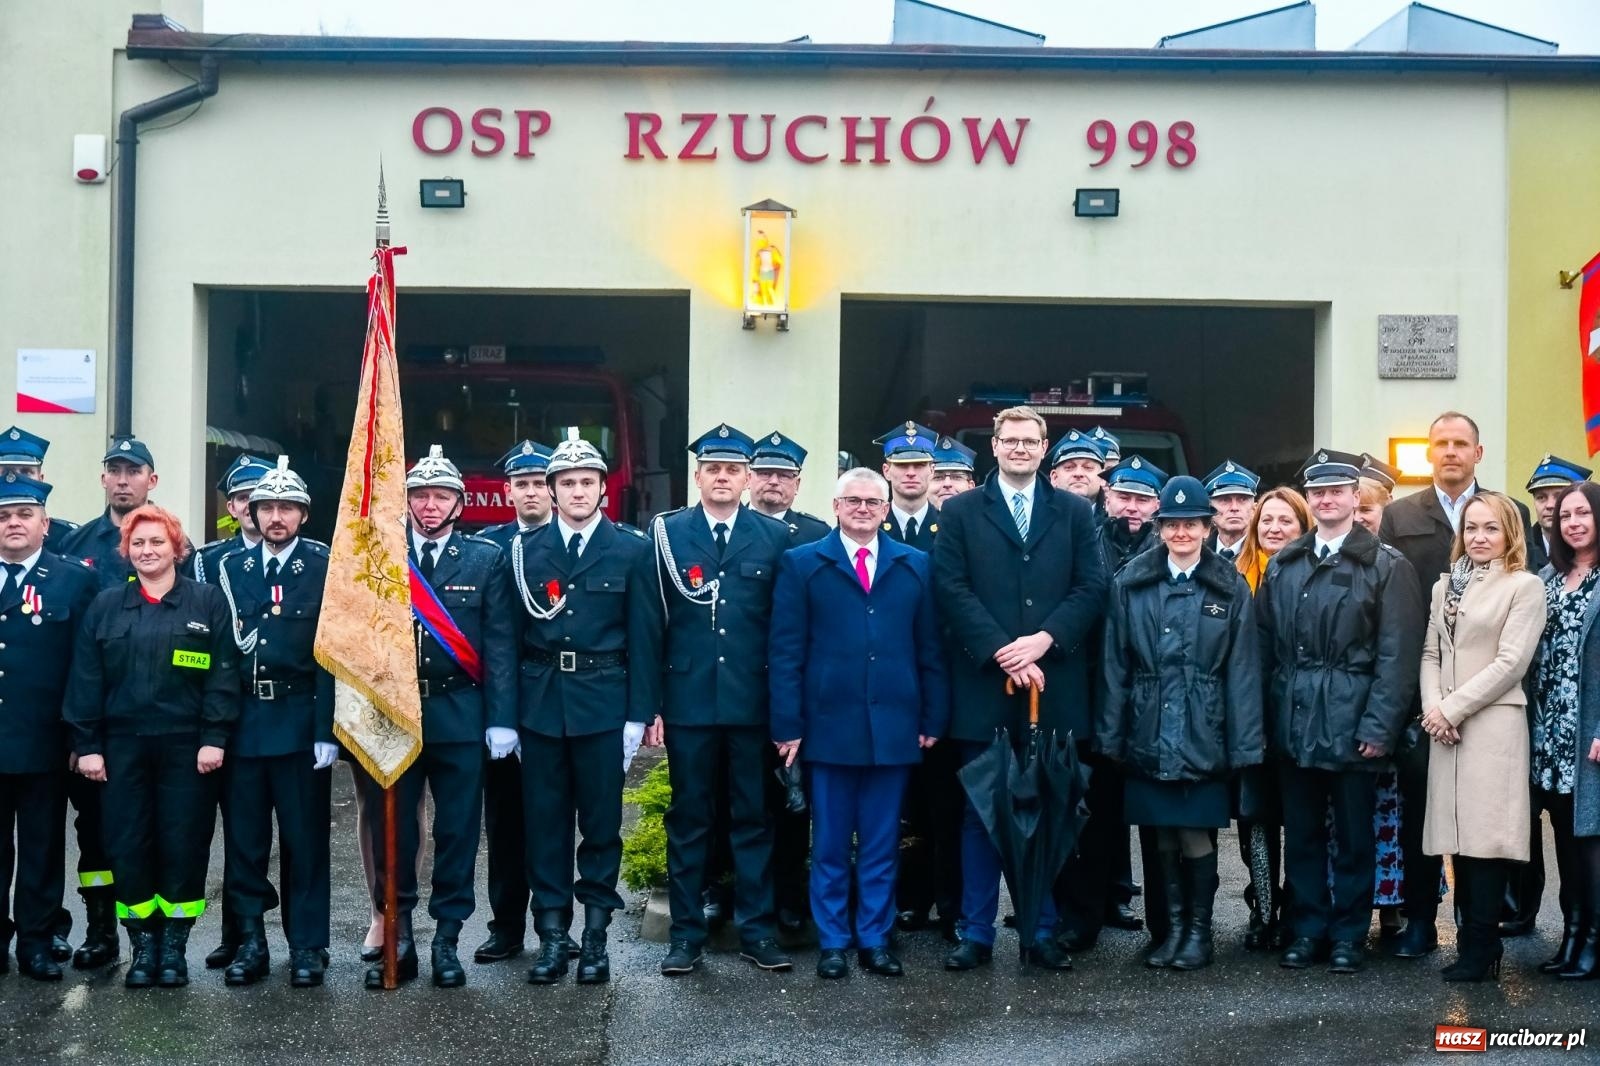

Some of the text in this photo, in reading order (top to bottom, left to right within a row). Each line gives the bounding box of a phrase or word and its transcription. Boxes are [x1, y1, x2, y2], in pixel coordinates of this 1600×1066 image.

[411, 97, 1198, 169] OSP RZUCHÓW 998
